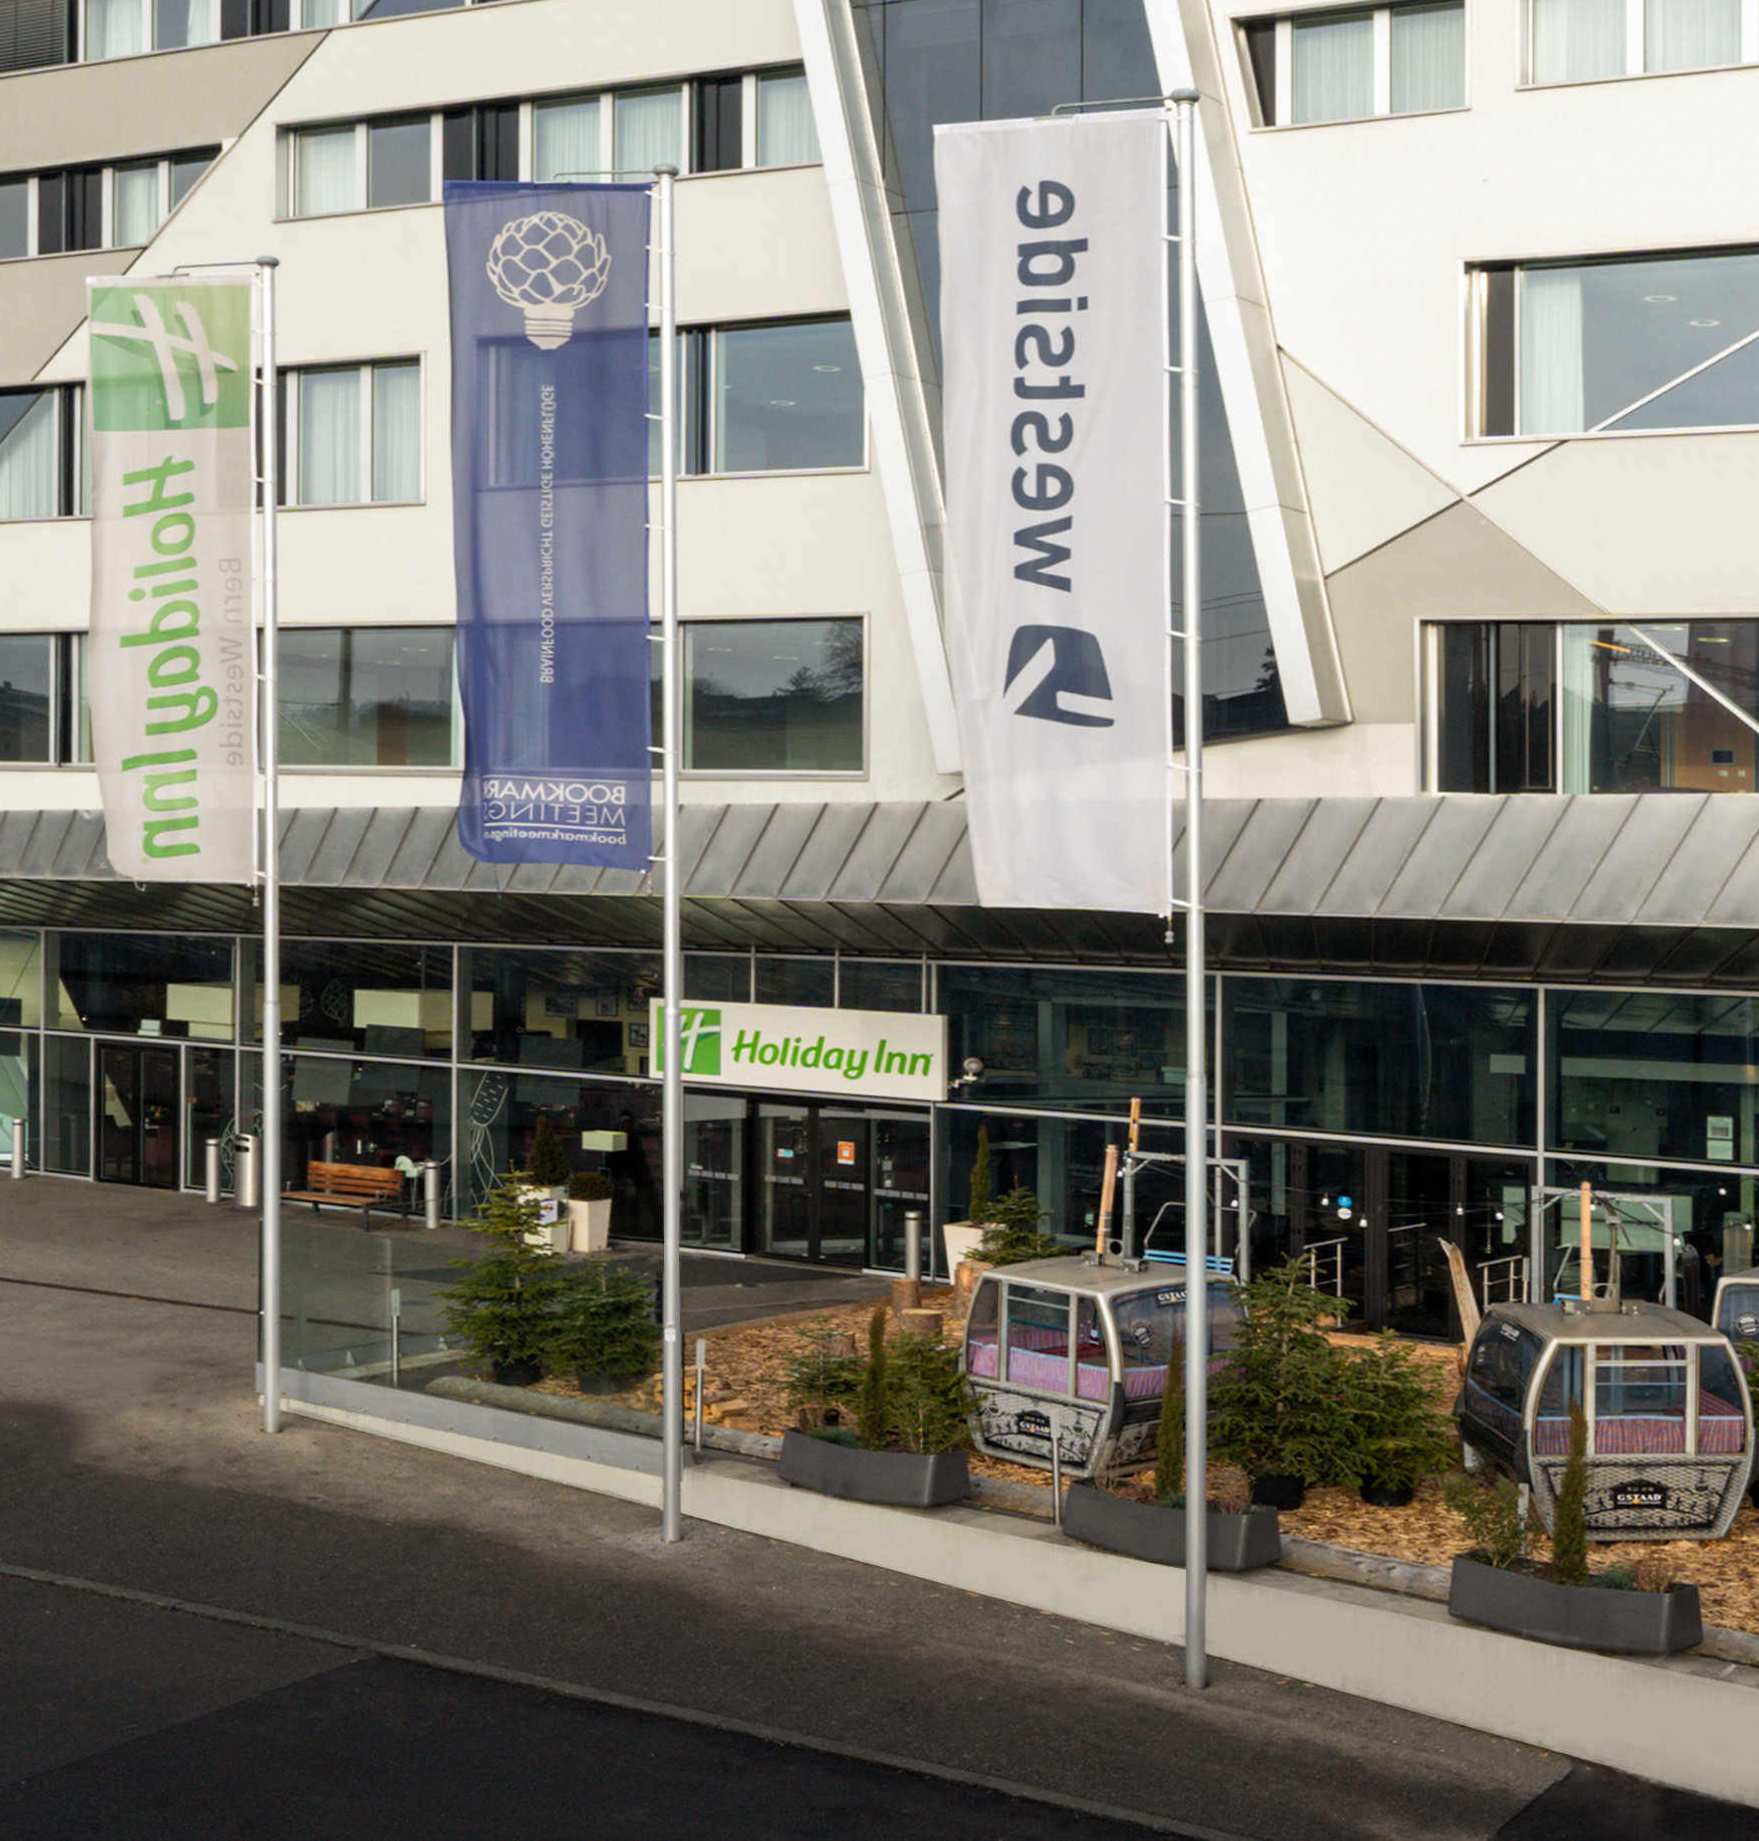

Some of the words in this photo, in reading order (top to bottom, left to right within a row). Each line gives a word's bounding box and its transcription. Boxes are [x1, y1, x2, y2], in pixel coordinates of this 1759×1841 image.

[731, 1029, 868, 1080] Holiday
[874, 1039, 932, 1077] Inn
[1617, 1493, 1662, 1501] GSTAAD
